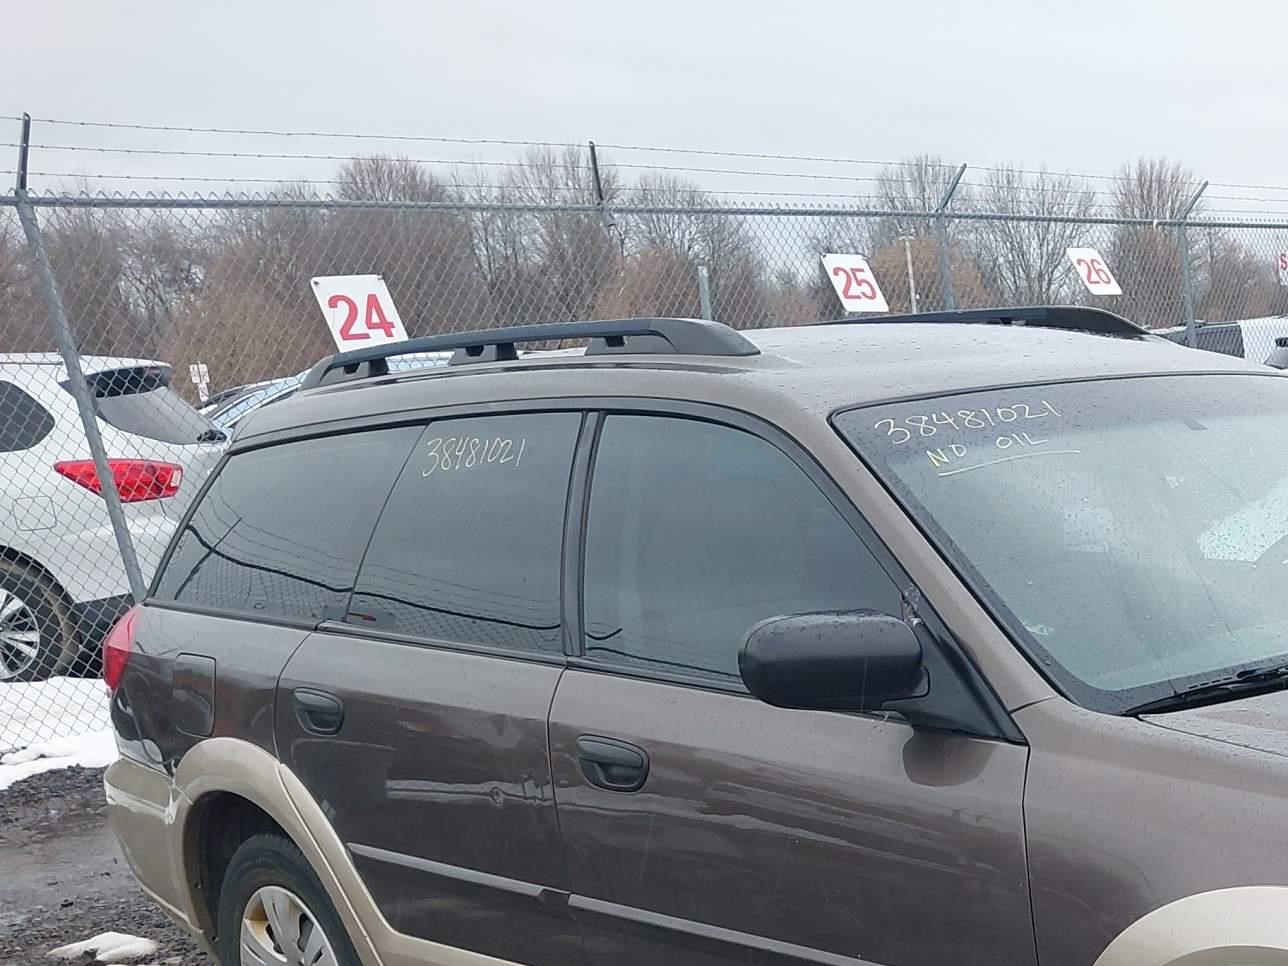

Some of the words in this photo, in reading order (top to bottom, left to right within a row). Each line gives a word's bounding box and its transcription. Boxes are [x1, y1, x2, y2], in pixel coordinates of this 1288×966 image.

[833, 266, 877, 300] 25
[1076, 258, 1111, 285] 26
[328, 293, 396, 341] 24
[874, 400, 1062, 445] 38481021
[996, 432, 1049, 449] OIL
[422, 437, 526, 477] 38481021
